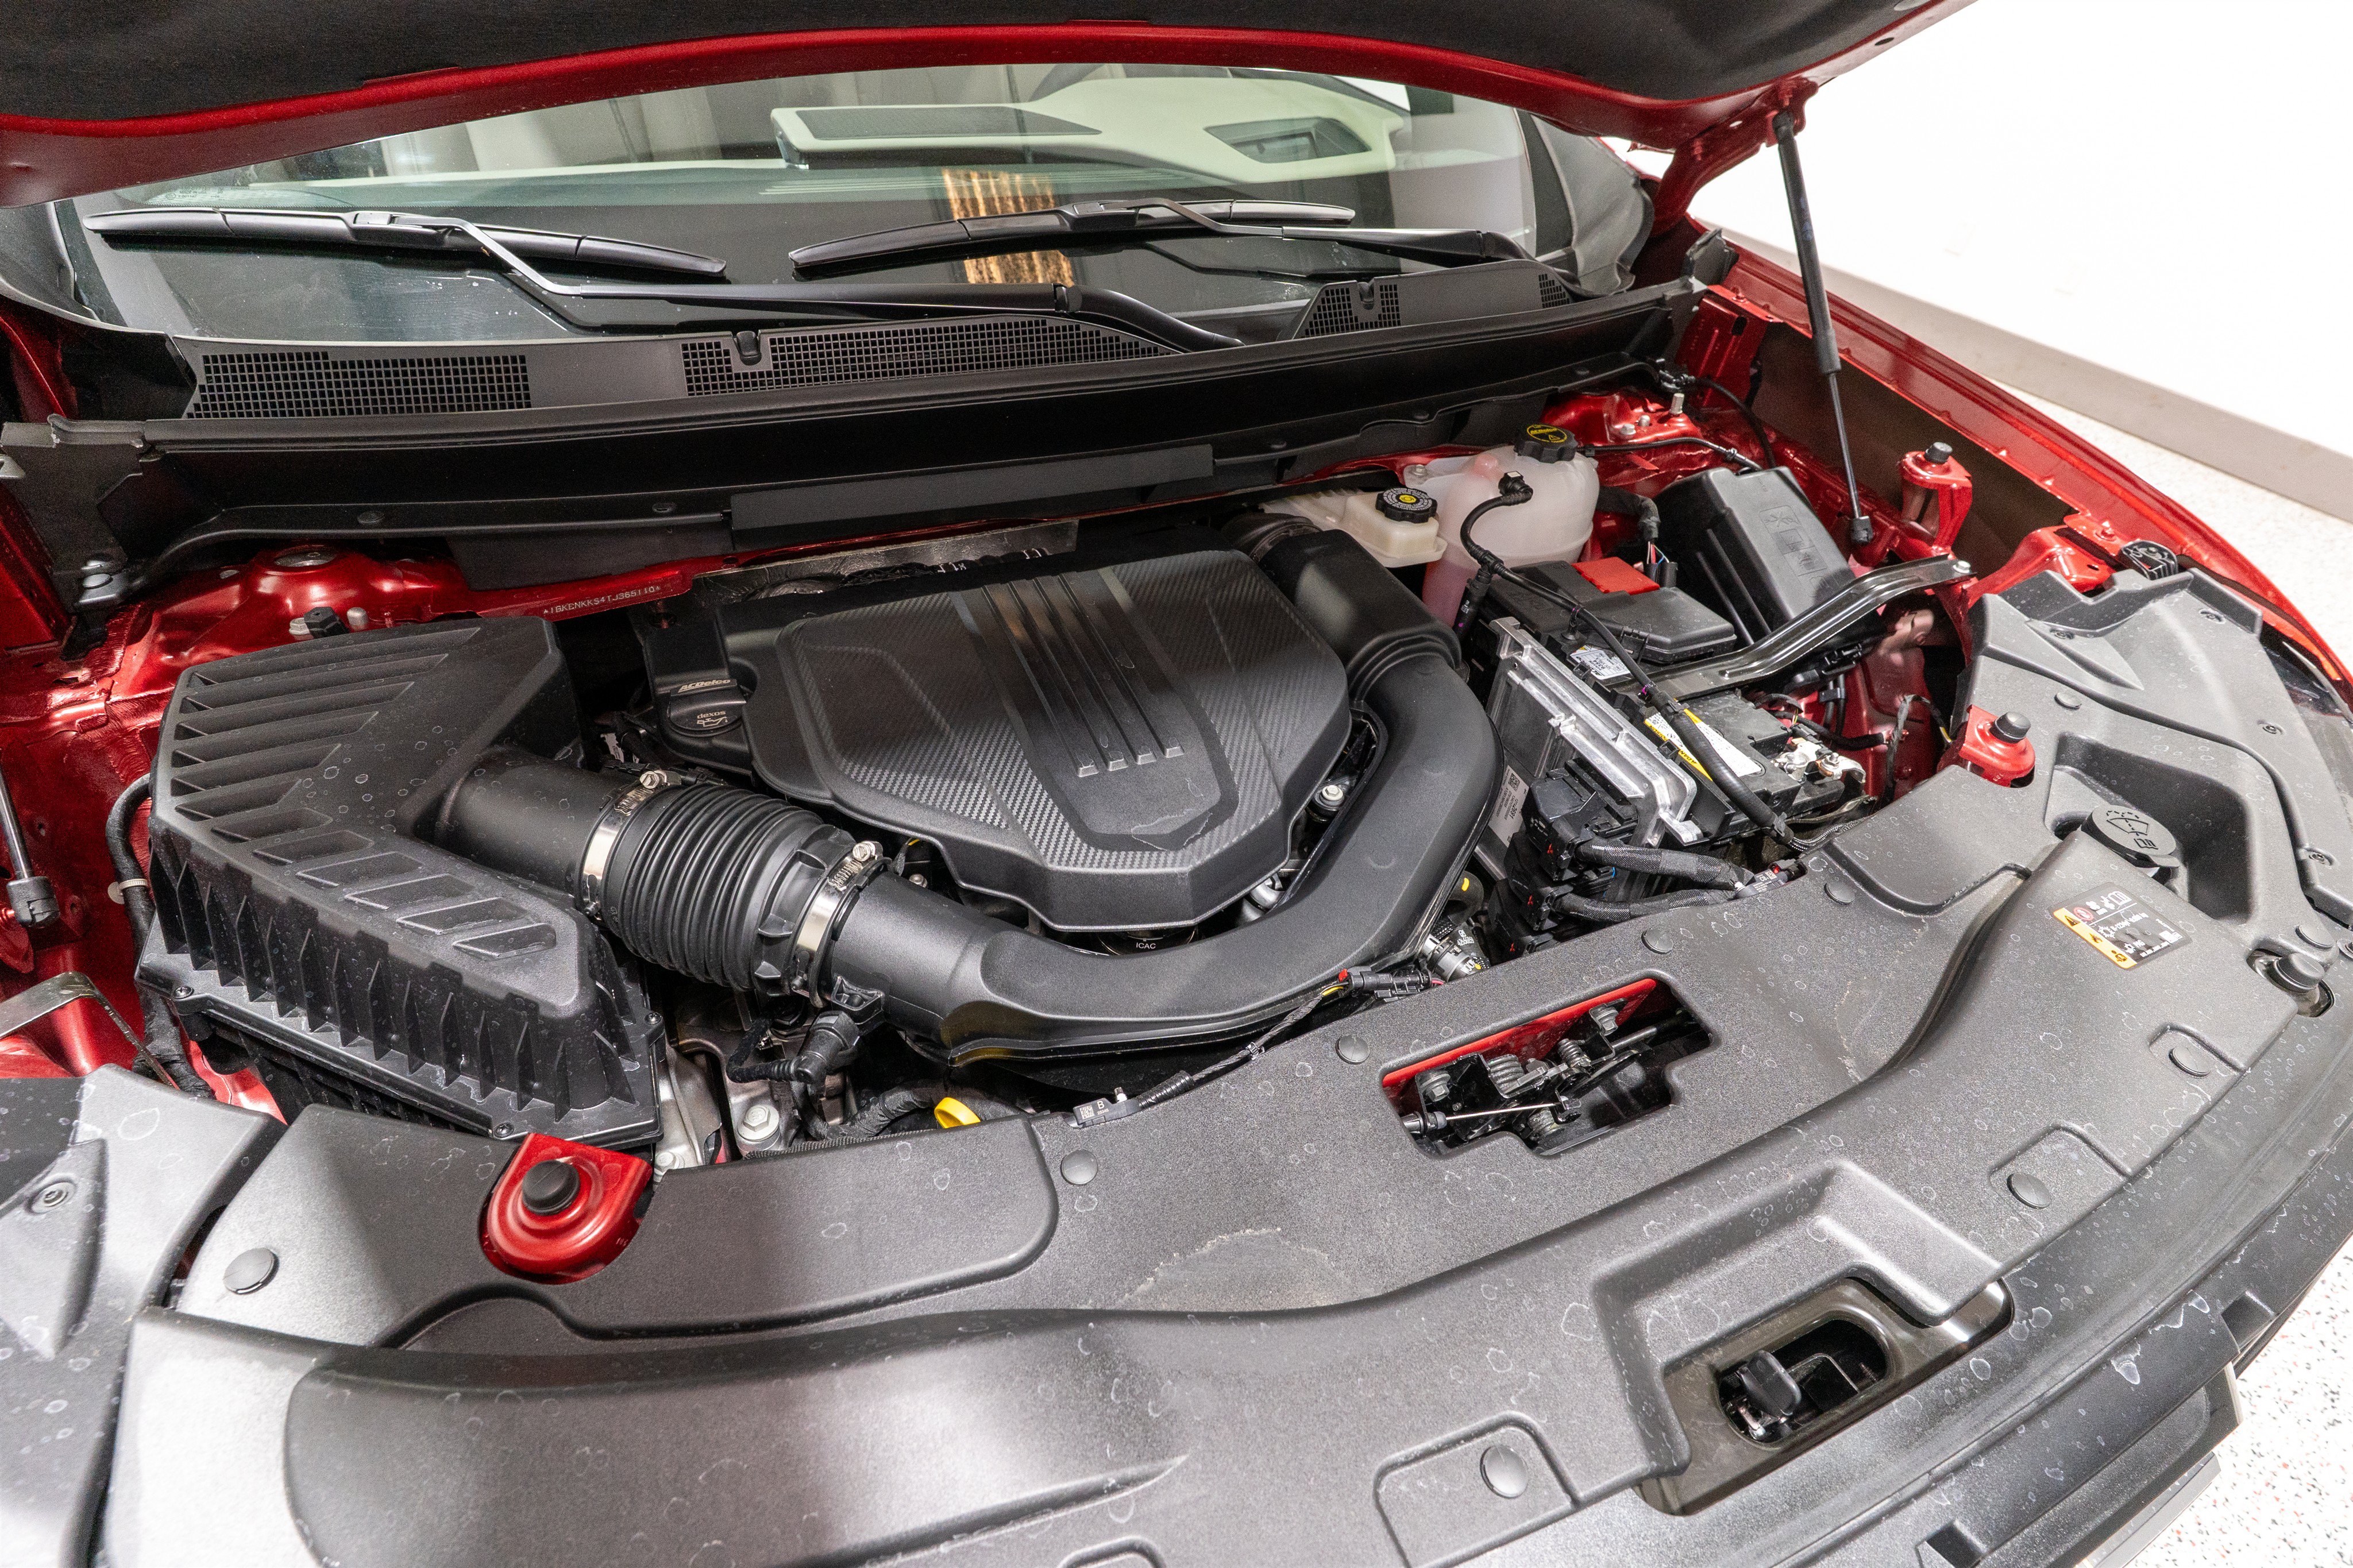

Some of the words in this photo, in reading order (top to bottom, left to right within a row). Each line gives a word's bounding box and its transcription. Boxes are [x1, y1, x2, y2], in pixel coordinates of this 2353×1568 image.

[678, 679, 731, 693] ACDelco
[697, 710, 726, 719] dexos
[1097, 1100, 1105, 1110] B
